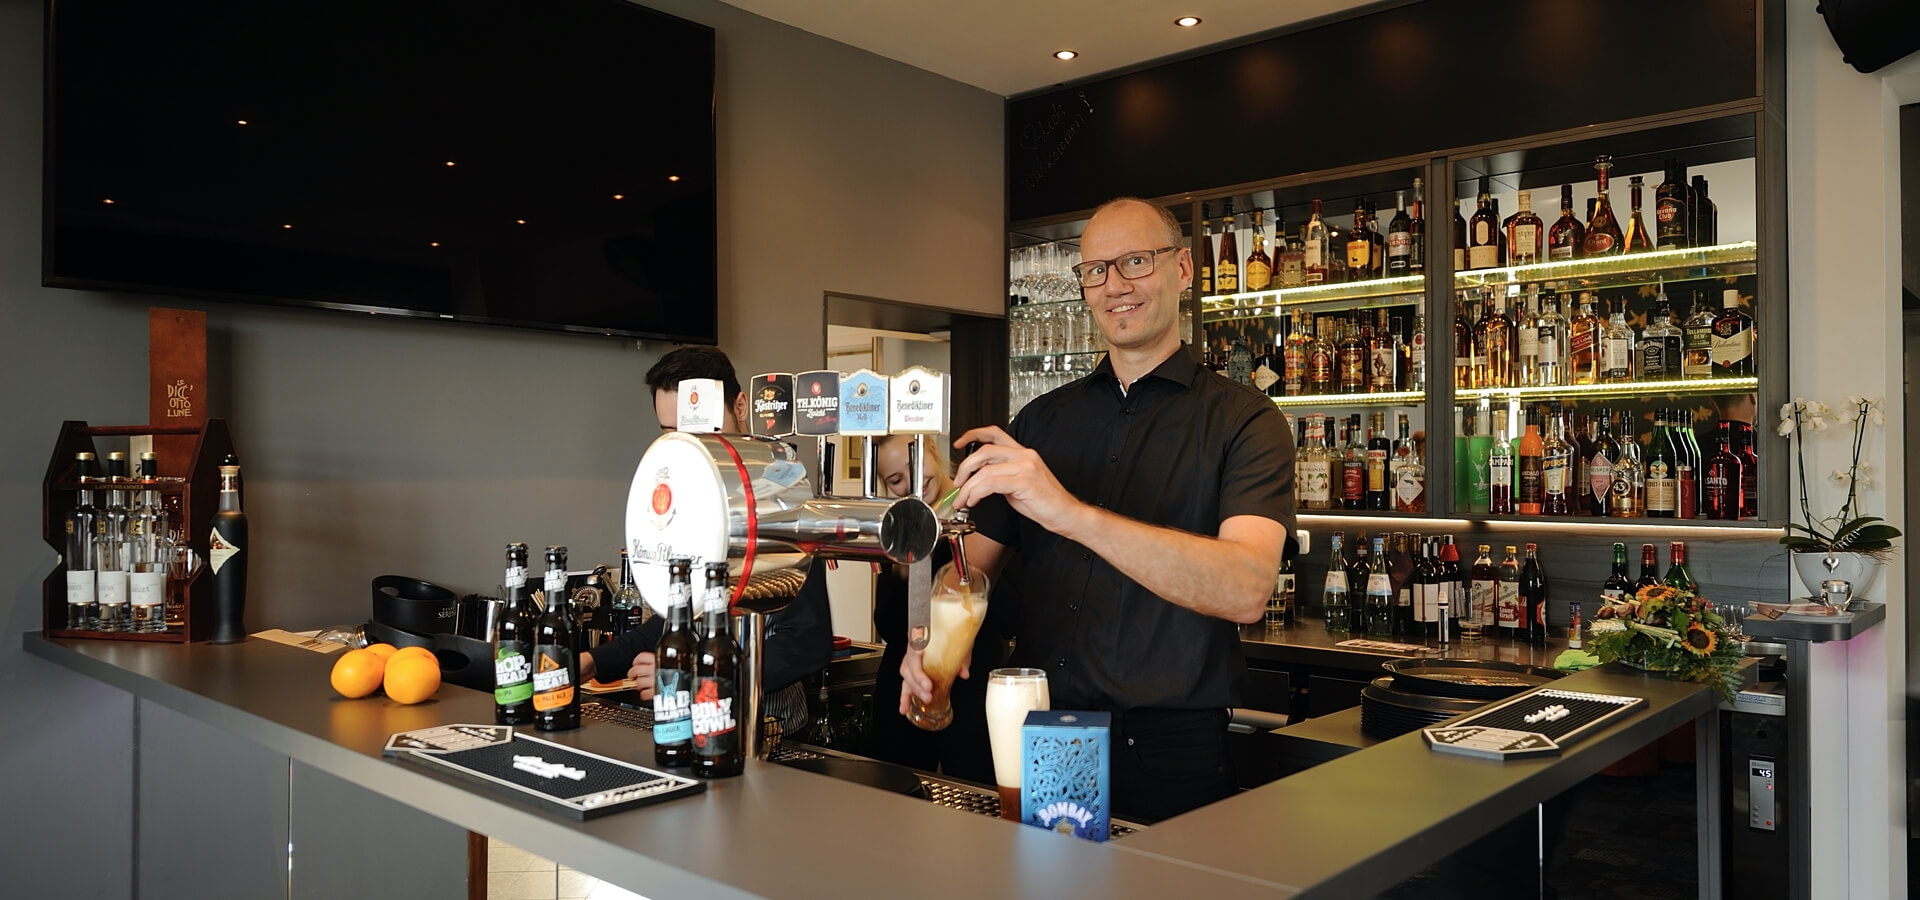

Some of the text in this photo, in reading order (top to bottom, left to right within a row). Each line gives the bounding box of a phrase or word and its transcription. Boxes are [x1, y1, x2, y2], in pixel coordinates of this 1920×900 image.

[169, 398, 191, 409] OTTO
[167, 409, 192, 417] LUNE
[1613, 482, 1625, 491] 43
[1038, 801, 1093, 828] BOMBAY
